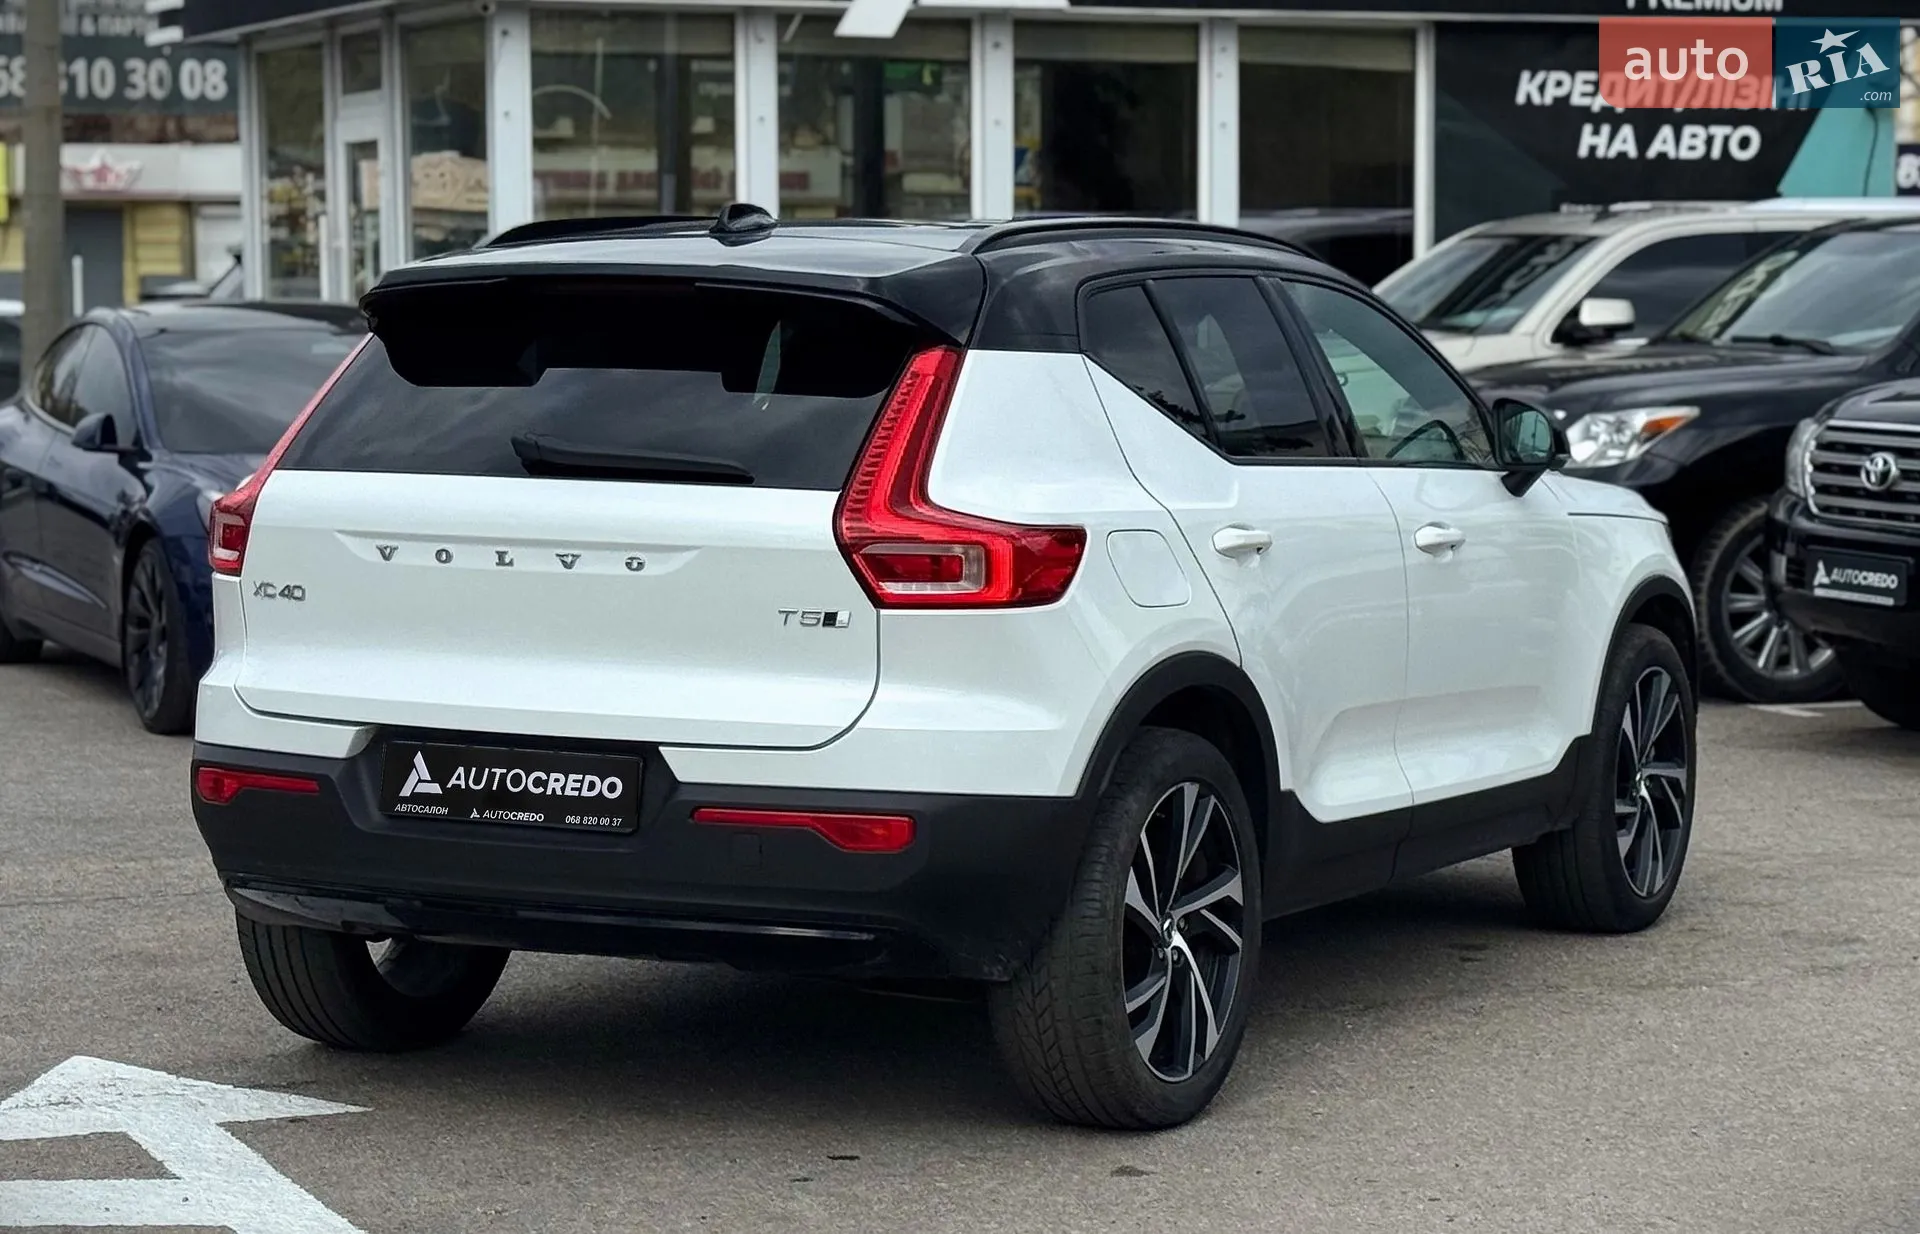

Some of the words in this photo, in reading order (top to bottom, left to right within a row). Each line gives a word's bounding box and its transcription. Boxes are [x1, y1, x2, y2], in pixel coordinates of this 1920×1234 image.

[123, 57, 173, 100] 30
[179, 58, 228, 101] 08
[1577, 123, 1639, 160] НА
[1645, 125, 1762, 162] АВТО
[375, 543, 647, 572] VOLVO
[1830, 567, 1898, 589] AUTOCREDO
[778, 607, 822, 627] T5
[447, 766, 623, 799] AUTOCREDO
[394, 803, 449, 815] АВТОСАЛОН
[482, 809, 545, 822] AUTOCREDO
[565, 815, 581, 824] 068
[582, 816, 598, 825] 820
[599, 817, 610, 826] 00
[611, 818, 622, 827] 37
